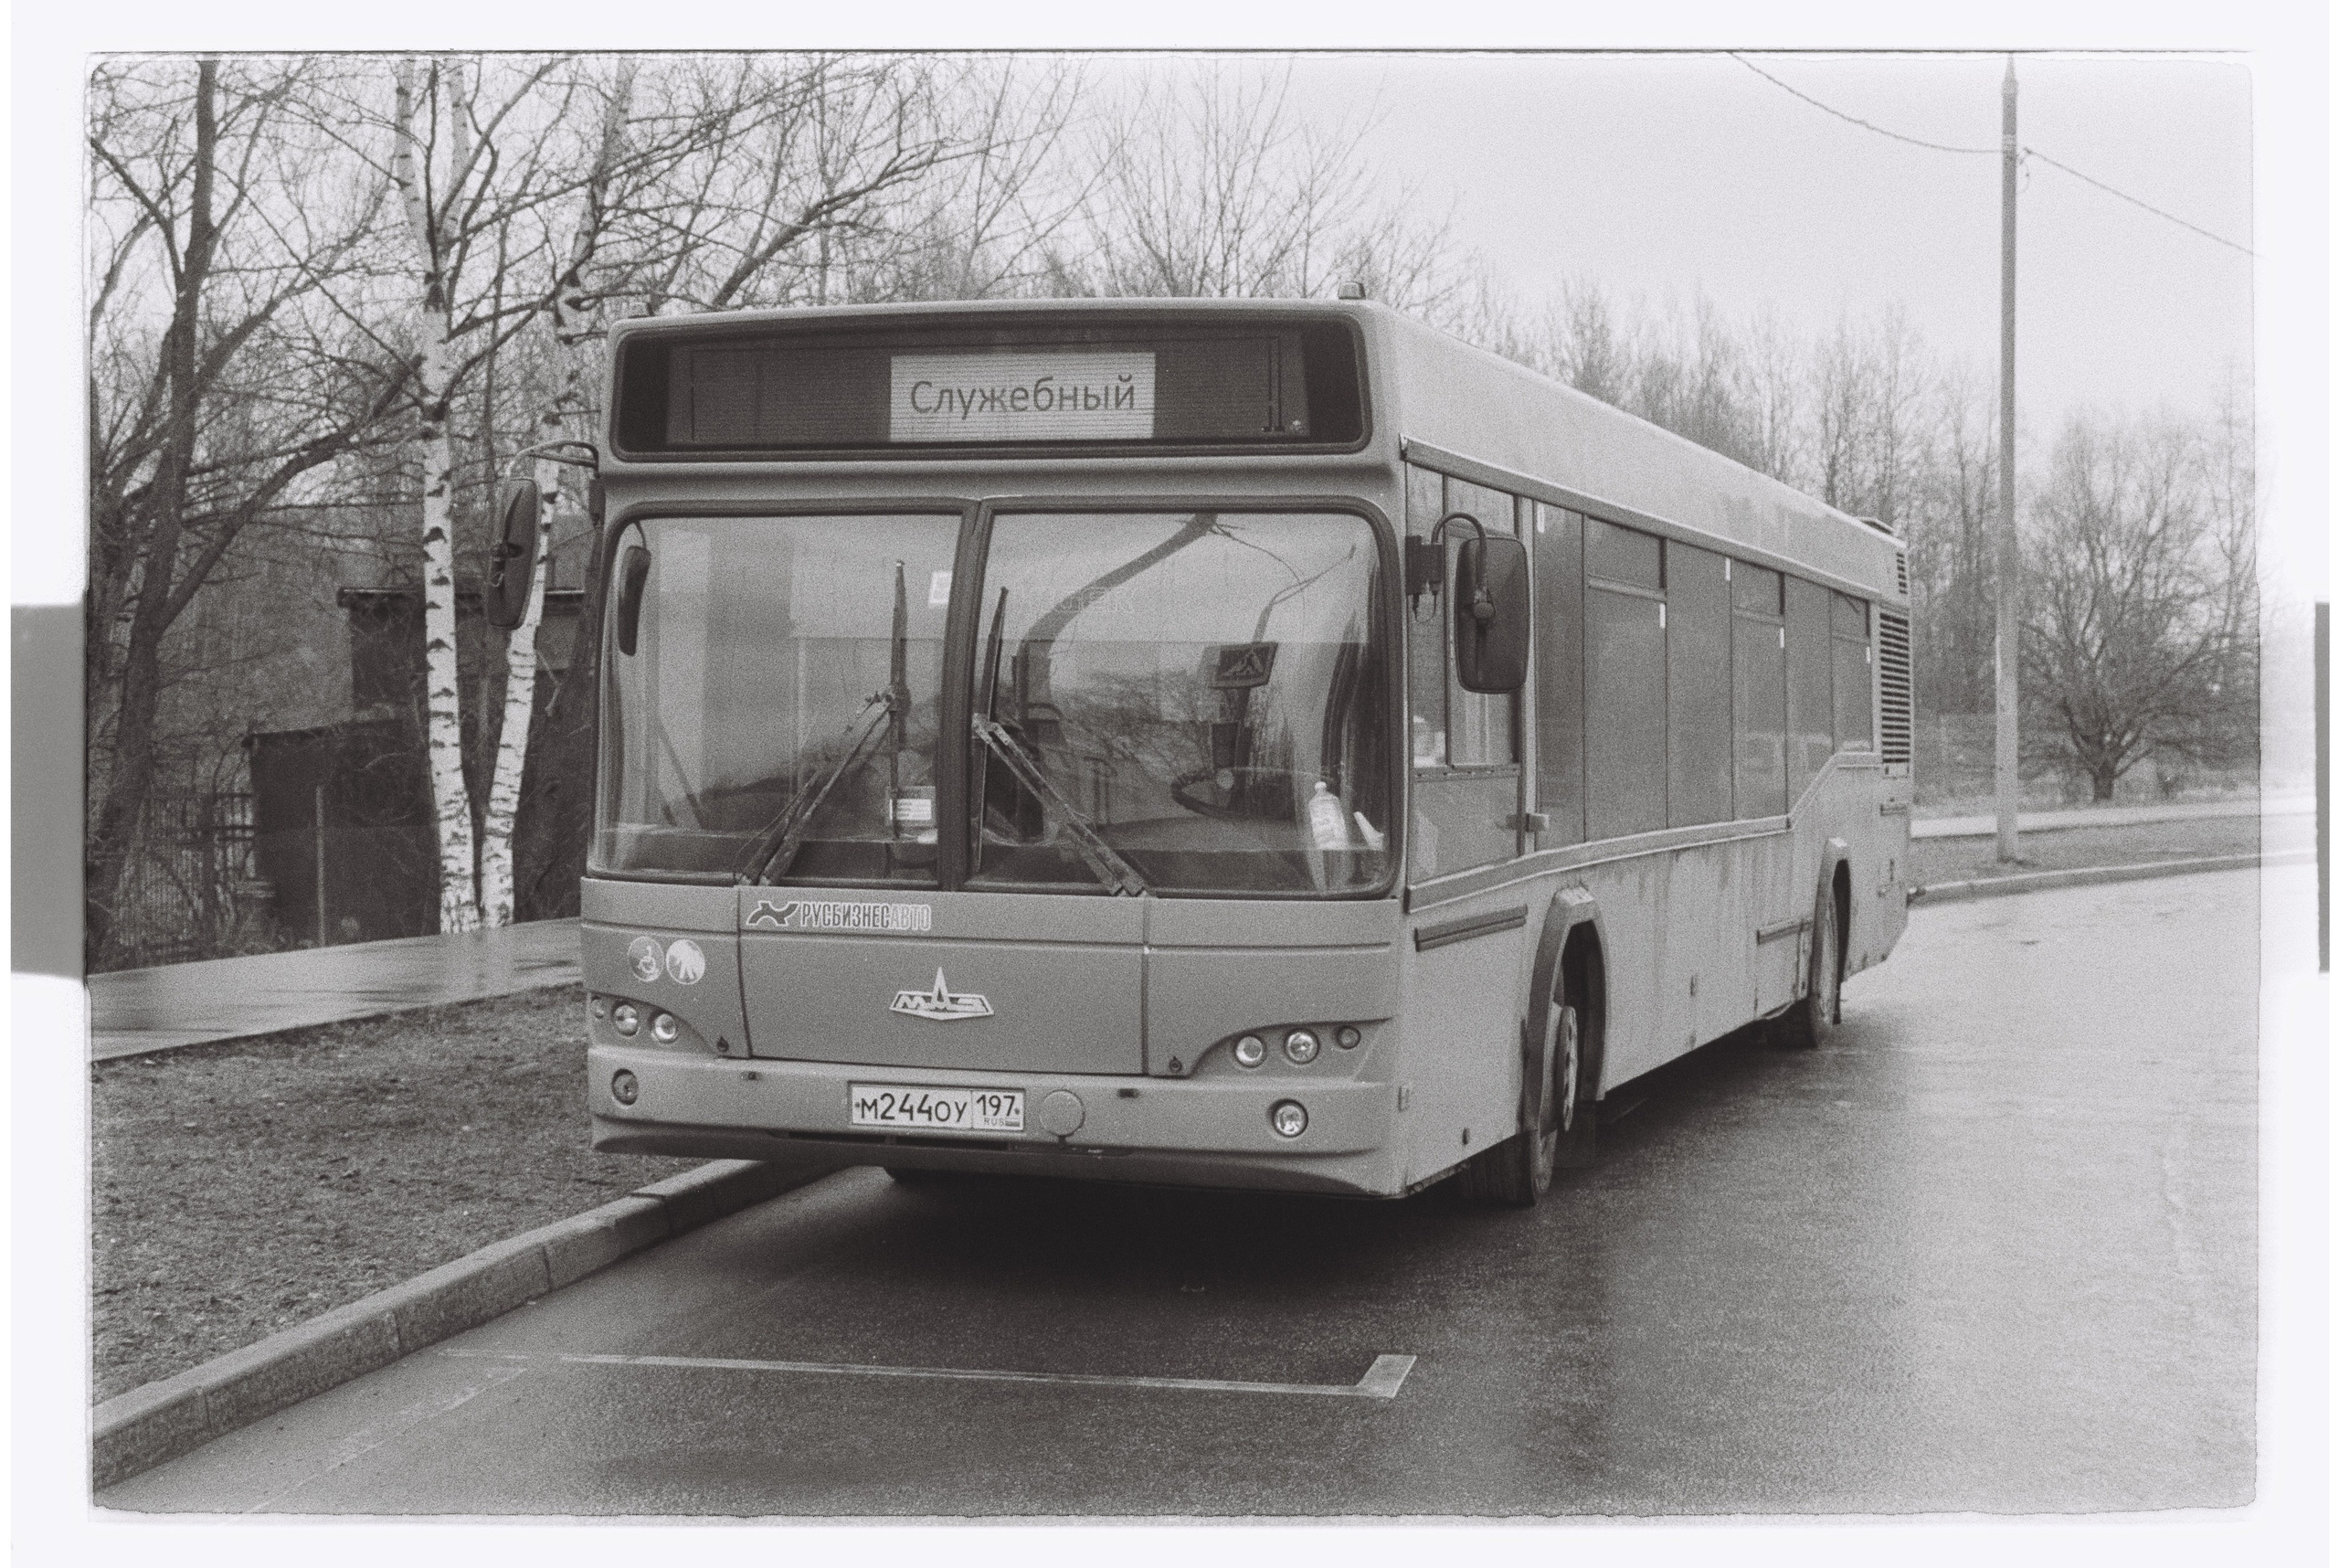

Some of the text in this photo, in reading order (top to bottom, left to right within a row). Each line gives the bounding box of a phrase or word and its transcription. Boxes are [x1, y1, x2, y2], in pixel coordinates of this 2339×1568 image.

[910, 374, 1136, 421] Служебный
[800, 901, 932, 930] РУСБИЗНЕСАВТО
[975, 1094, 1017, 1118] 197
[983, 1117, 1004, 1128] RUS
